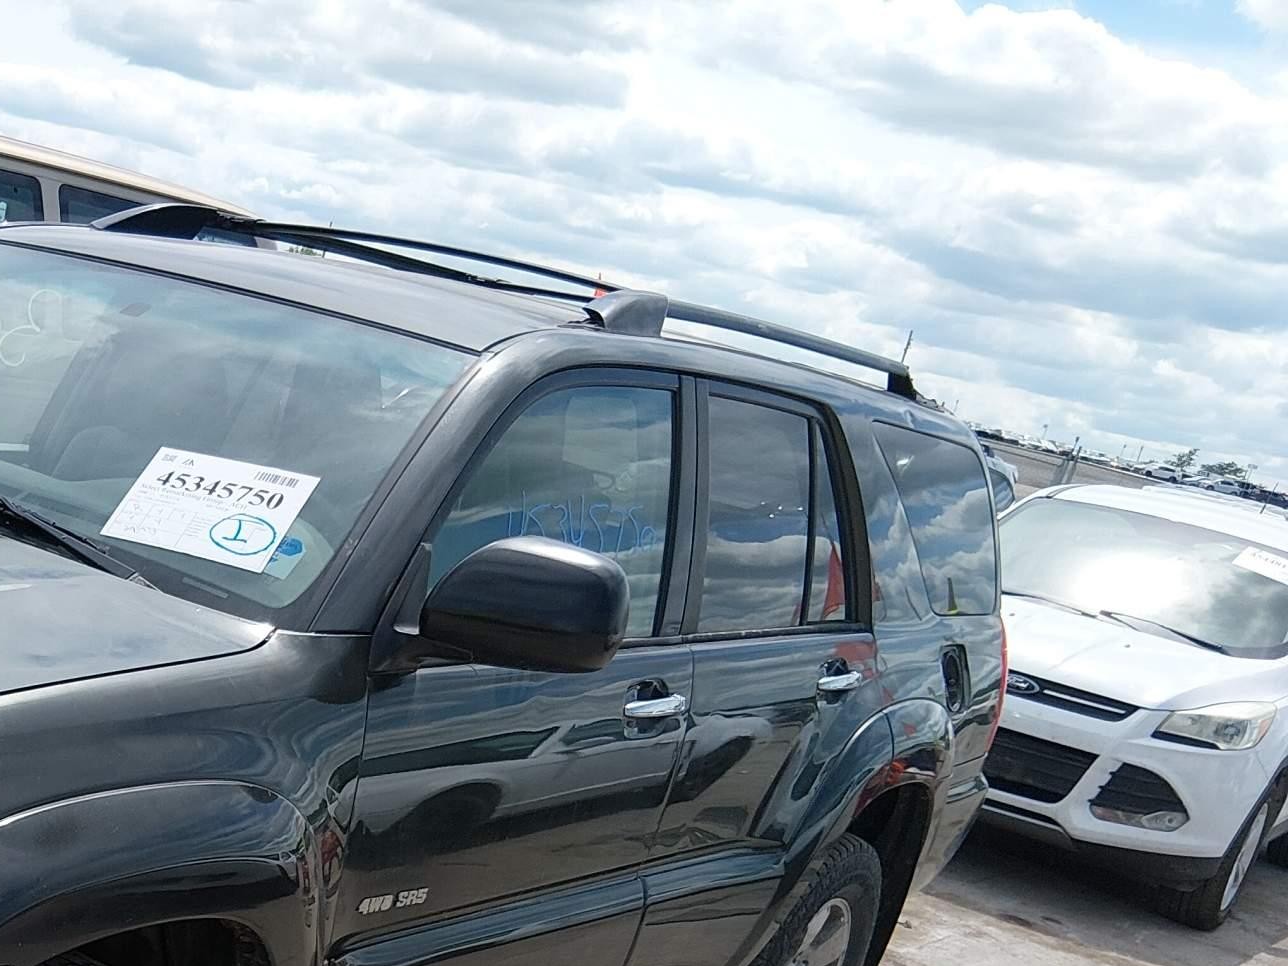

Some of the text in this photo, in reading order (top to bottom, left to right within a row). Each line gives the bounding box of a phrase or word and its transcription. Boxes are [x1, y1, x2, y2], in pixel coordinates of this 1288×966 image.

[156, 470, 284, 510] 45345750
[357, 887, 429, 915] 4WD SR5
